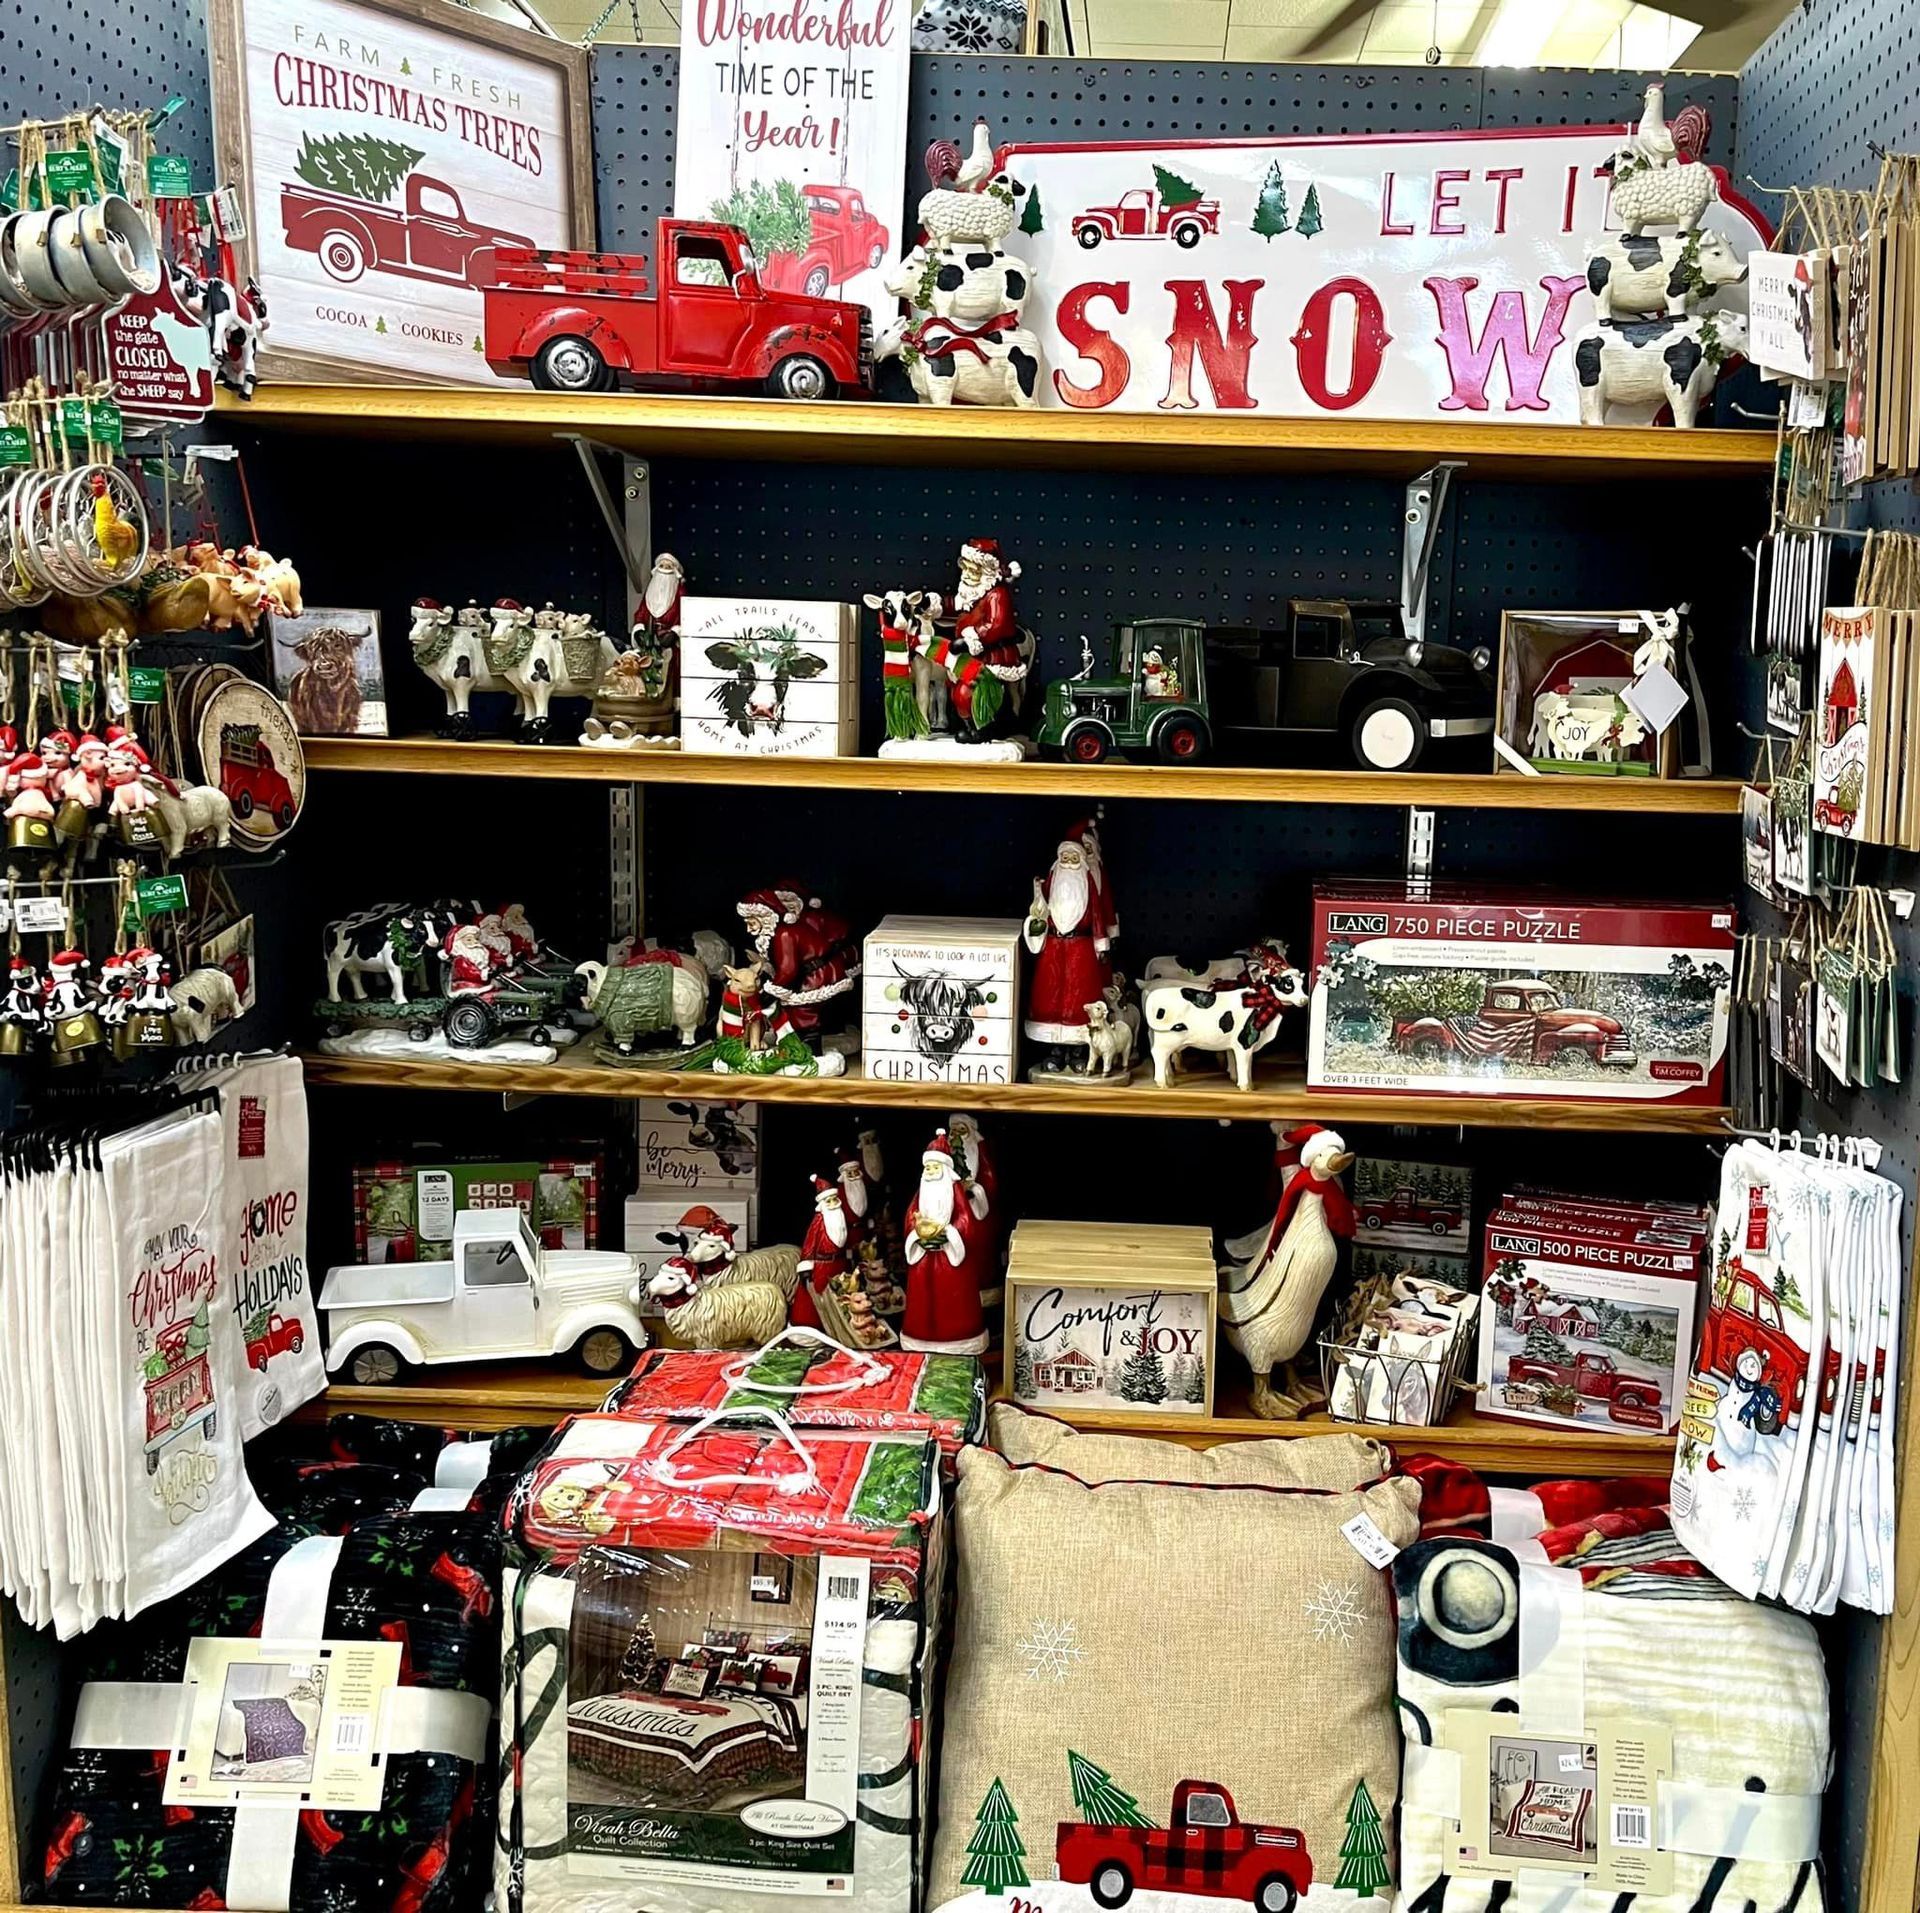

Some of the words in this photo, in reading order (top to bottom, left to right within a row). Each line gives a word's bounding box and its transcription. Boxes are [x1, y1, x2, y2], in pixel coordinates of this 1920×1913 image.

[294, 25, 382, 67] FARM
[433, 67, 522, 111] FRESH
[715, 62, 774, 95] TIME
[784, 66, 818, 97] OF
[825, 67, 875, 100] THE
[273, 51, 448, 132] CHRISTMAS
[455, 105, 544, 177] TREES
[1380, 166, 1524, 237] LET
[1758, 277, 1785, 295] MERRY
[119, 314, 148, 329] KEEP
[1751, 300, 1795, 325] CHRISTMAS
[114, 330, 133, 342] the
[135, 331, 159, 345] gate
[316, 306, 369, 329] COCOA
[401, 322, 465, 347] COOKIES
[1053, 276, 1586, 412] SNOW
[115, 346, 168, 369] CLOSED
[117, 370, 129, 379] no
[130, 370, 162, 380] matter
[163, 372, 187, 383] what
[120, 386, 136, 396] the
[137, 384, 166, 397] SHEEP
[168, 389, 184, 401] say
[705, 615, 724, 630] ALL
[789, 614, 816, 634] LEAD
[1823, 611, 1874, 640] MERRY
[697, 719, 727, 745] HOME
[735, 742, 749, 752] AT
[760, 725, 823, 755] CHRISTMAS
[1562, 726, 1590, 741] JOY
[1332, 916, 1385, 932] LANG
[1394, 917, 1429, 934] 750
[1436, 919, 1496, 937] PIECE
[1504, 920, 1581, 940] PUZZLE
[935, 951, 944, 960] TO
[977, 952, 991, 962] LOT
[873, 1059, 1006, 1084] CHRISTMAS
[1323, 1074, 1349, 1085] OVER
[1351, 1076, 1357, 1085] 3
[1359, 1076, 1382, 1086] FEET
[1384, 1076, 1409, 1087] WIDE
[433, 1196, 450, 1204] DAYS
[1495, 1216, 1521, 1224] 500
[1524, 1219, 1564, 1230] PIECE
[1567, 1225, 1621, 1238] PUZZLE
[1494, 1237, 1537, 1253] LANG
[1543, 1242, 1571, 1256] 500
[1575, 1247, 1619, 1264] PIECE
[1624, 1253, 1683, 1272] PUZZL
[234, 1254, 304, 1327] HOLIDAYS
[1025, 1287, 1192, 1356] Comfort
[137, 1328, 150, 1354] BE
[1521, 1817, 1571, 1836] Christmas
[592, 1834, 616, 1845] Quilt
[619, 1837, 668, 1849] Collection
[768, 1840, 785, 1849] King
[803, 1841, 821, 1850] Quilt
